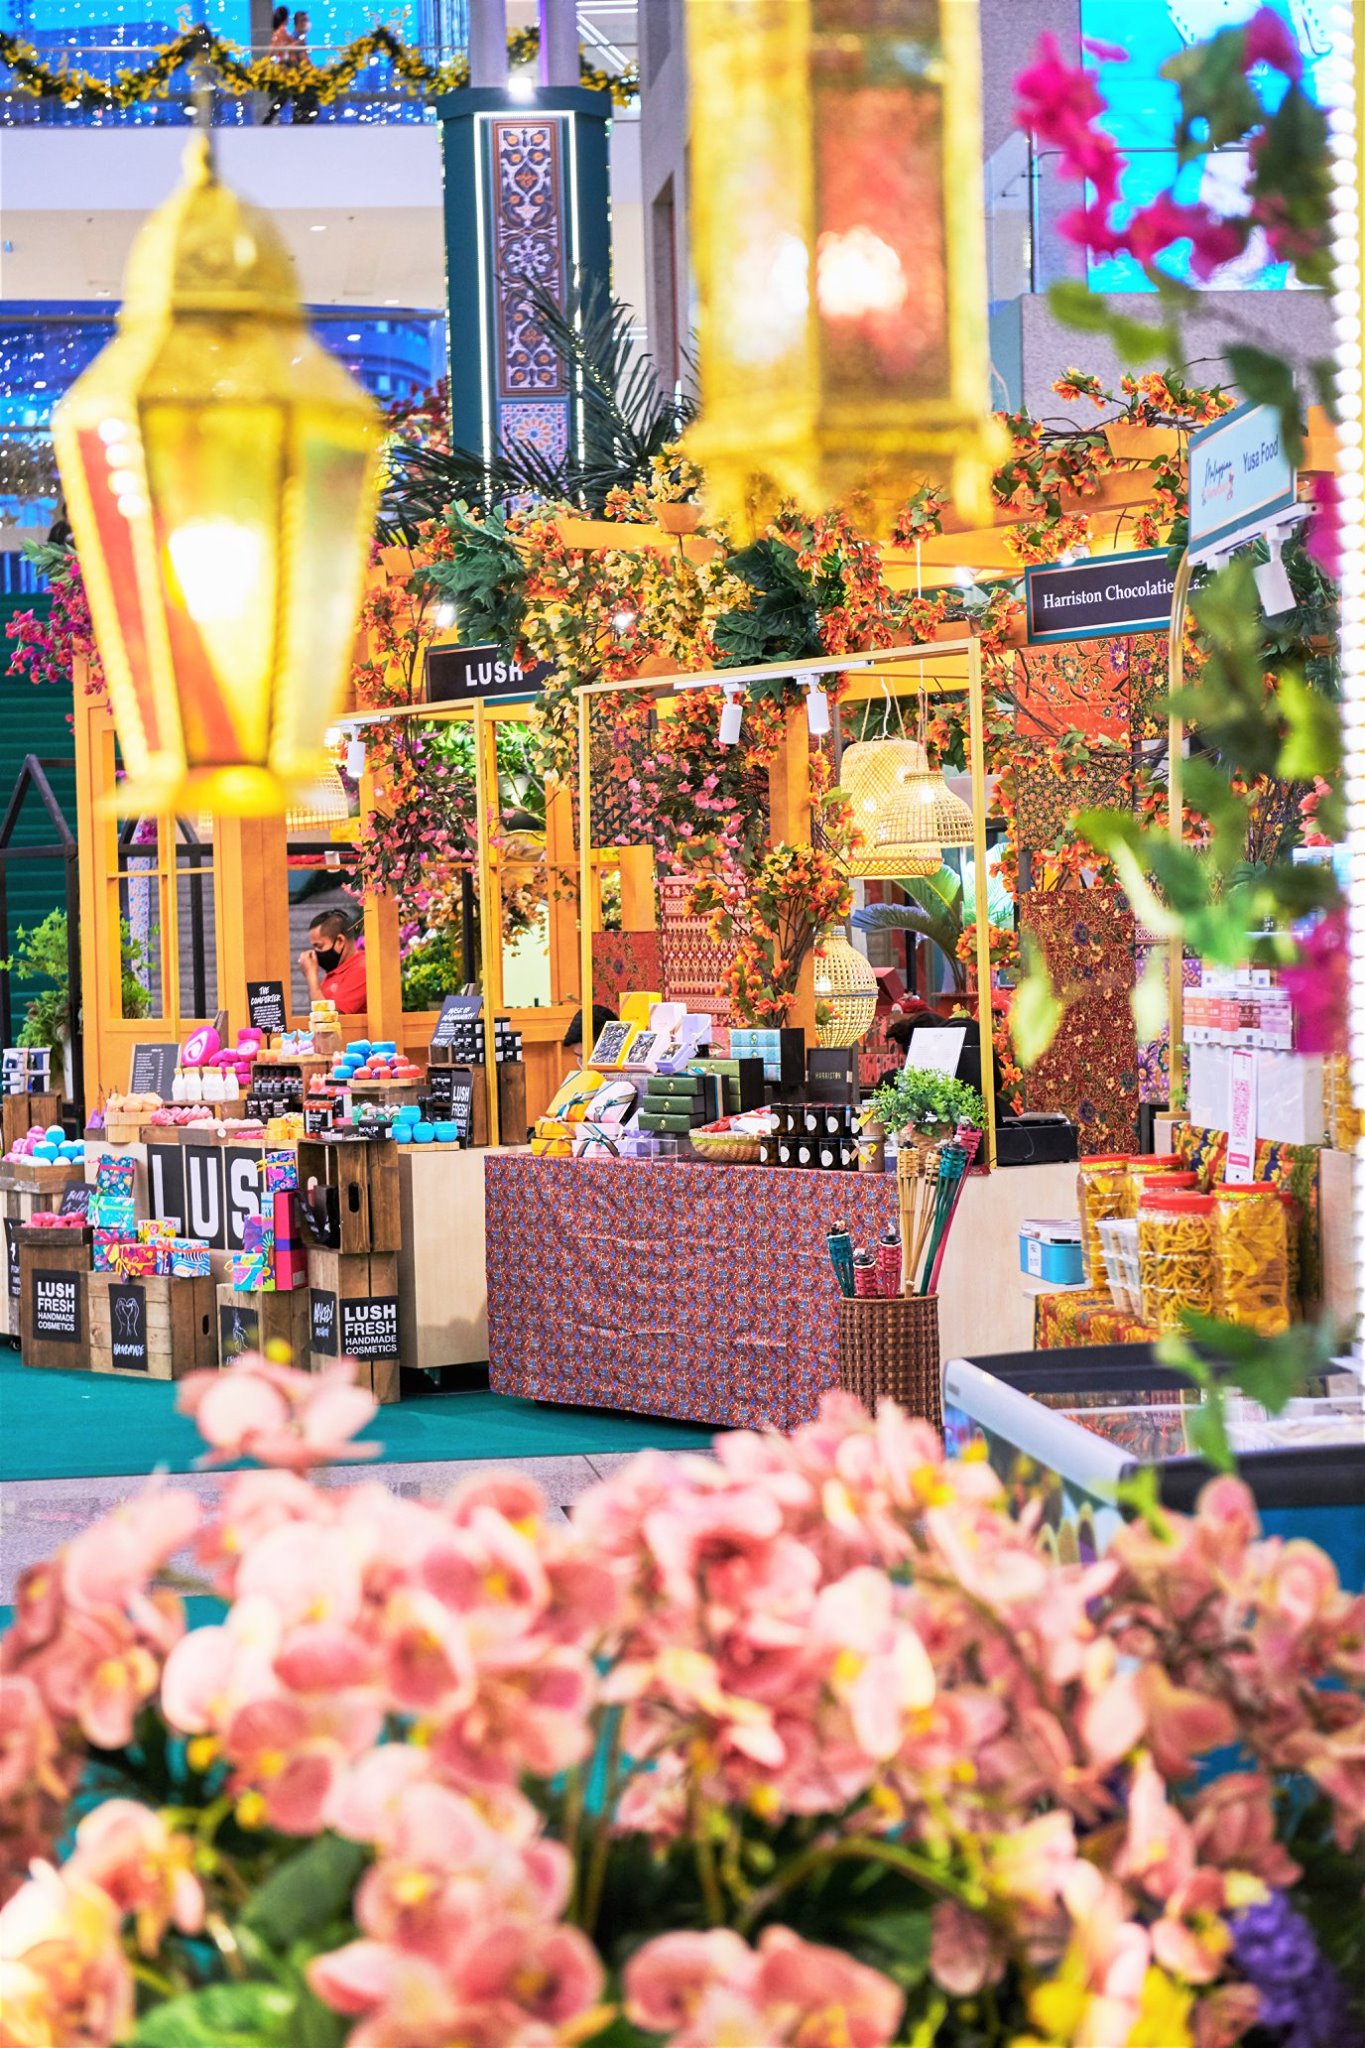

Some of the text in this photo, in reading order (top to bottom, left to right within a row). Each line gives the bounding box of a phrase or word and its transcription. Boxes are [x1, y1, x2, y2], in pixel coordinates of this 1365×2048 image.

[1242, 433, 1279, 474] Yusa Food
[1043, 591, 1102, 609] Harriston
[1105, 578, 1175, 601] Chocolatie
[465, 660, 524, 687] LUSH
[452, 1085, 470, 1102] LUSH
[451, 1102, 469, 1118] FRESH
[152, 1154, 261, 1240] LUS
[37, 1281, 75, 1298] LUSH
[37, 1297, 75, 1313] FRESH
[344, 1304, 397, 1321] LUSH
[37, 1312, 75, 1323] HANDMADE
[37, 1321, 75, 1333] COSMETICS
[344, 1320, 397, 1336] FRESH
[345, 1334, 397, 1346] HANDMADE
[345, 1344, 397, 1355] COSMETICS
